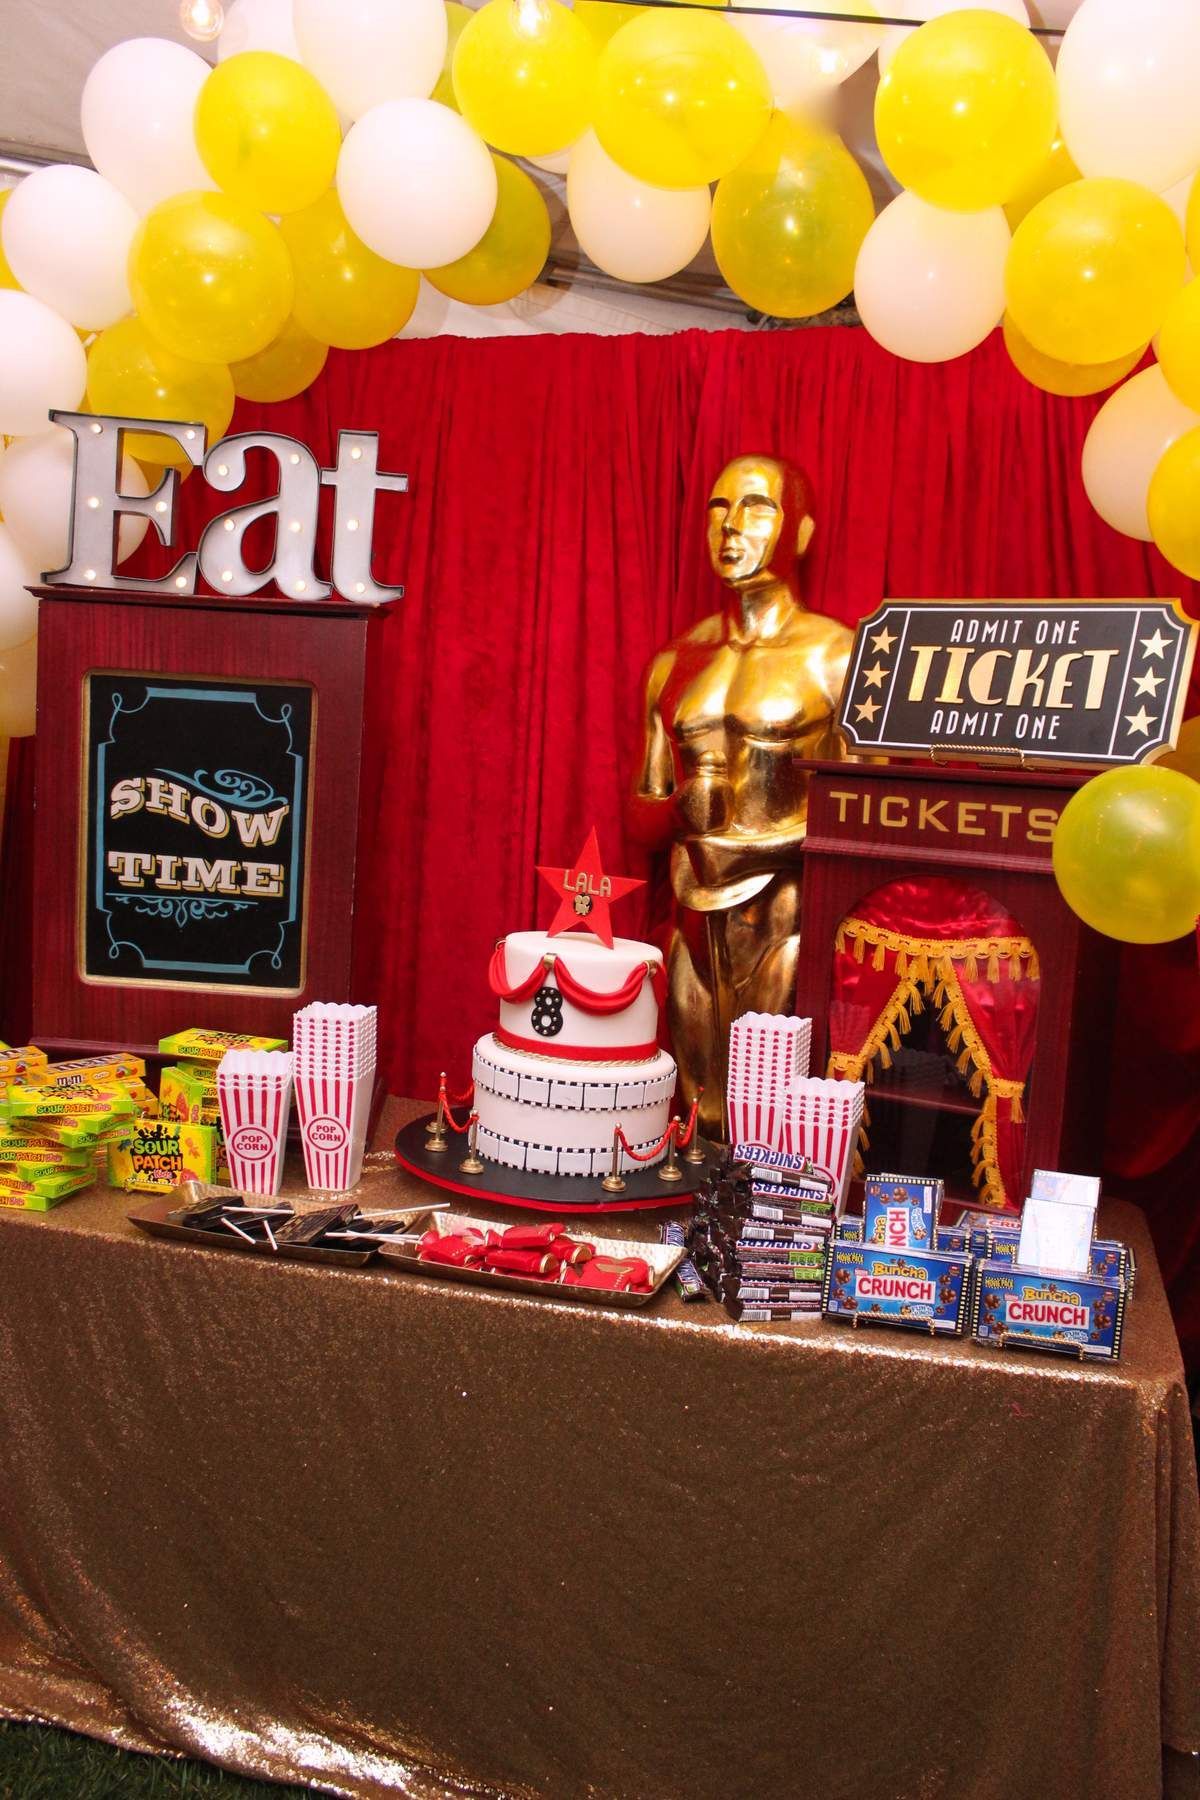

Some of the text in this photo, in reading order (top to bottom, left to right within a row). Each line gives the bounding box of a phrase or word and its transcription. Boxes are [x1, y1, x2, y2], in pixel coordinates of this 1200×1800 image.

[40, 409, 408, 603] Eat
[950, 619, 1081, 645] ADMIT ONE
[907, 645, 1120, 711] TICKET
[930, 709, 1061, 740] ADMIT ONE
[110, 776, 290, 848] SHOW
[829, 791, 1059, 844] TICKETS
[108, 850, 285, 898] TIME
[563, 869, 612, 897] LALA
[531, 986, 564, 1037] 8
[37, 1105, 64, 1114] SOUR
[241, 1135, 263, 1143] POP
[311, 1133, 341, 1142] CORN
[316, 1124, 337, 1134] POP
[133, 1139, 179, 1155] SOUR
[236, 1143, 268, 1152] CORN
[735, 1144, 804, 1170] SNICKERS
[132, 1155, 182, 1171] PATCH
[873, 1262, 927, 1280] Buncha
[858, 1277, 932, 1300] CRUNCH
[1024, 1287, 1079, 1305] Buncha
[1008, 1303, 1086, 1325] CRUNCH
